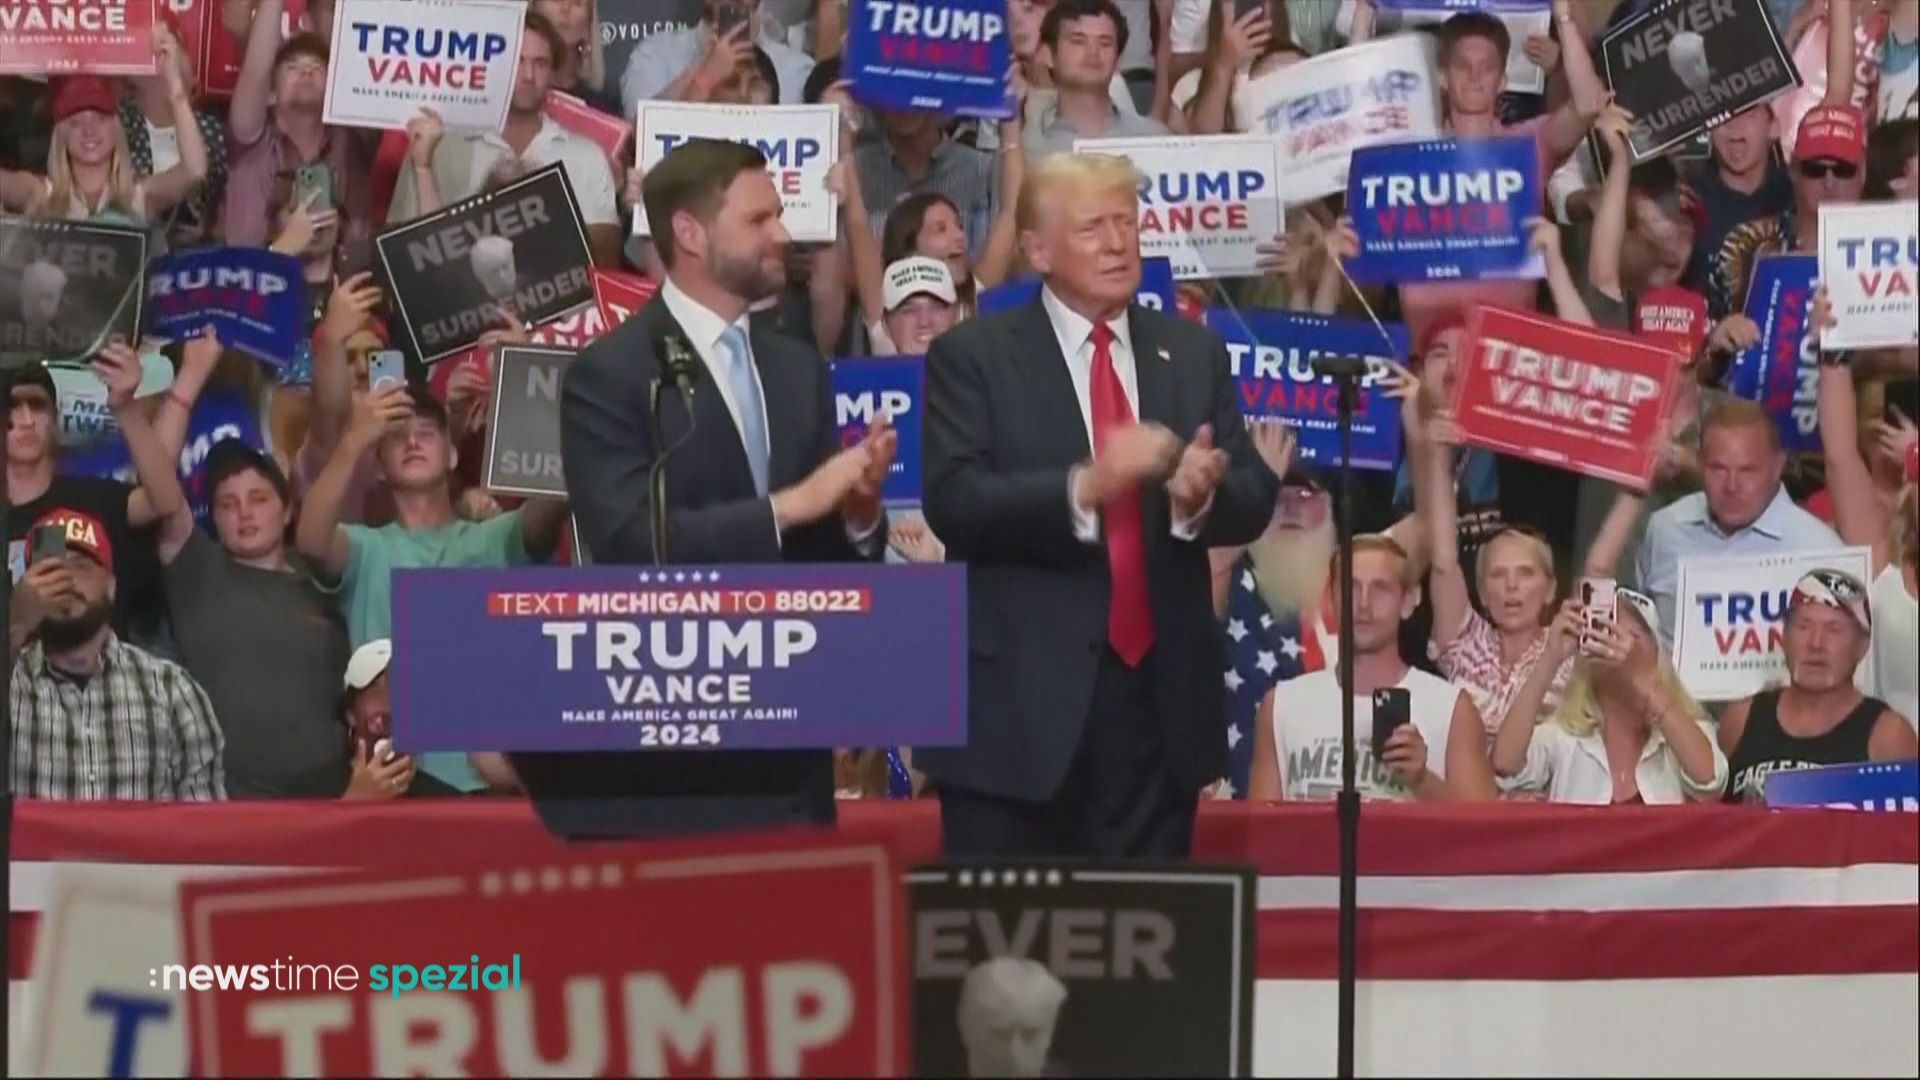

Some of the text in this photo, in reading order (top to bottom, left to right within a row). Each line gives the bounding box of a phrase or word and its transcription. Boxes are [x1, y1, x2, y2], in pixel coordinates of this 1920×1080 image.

[0, 6, 126, 30] VANCE
[867, 1, 1003, 42] TRUMP
[1620, 0, 1736, 70] NEVER
[352, 22, 507, 62] TRUMP
[368, 57, 488, 90] VANCE
[1628, 56, 1780, 143] SURRENDER
[655, 134, 820, 168] TMP
[1137, 170, 1265, 204] RUMP
[1361, 169, 1524, 209] TRUMP
[407, 196, 550, 273] NEVER
[1141, 204, 1249, 233] ANCE
[420, 267, 590, 345] SURRENDER
[1478, 337, 1661, 405] TRUMP
[1491, 374, 1637, 435] VANCE
[498, 591, 861, 615] TEXT MICHIGAN TO 88022
[542, 621, 818, 670] TRUMP
[606, 675, 751, 704] VANCE
[562, 710, 605, 722] MAKE
[611, 709, 681, 721] AMERICA
[687, 709, 738, 720] GREAT
[640, 724, 721, 746] 2024
[915, 909, 1177, 980] EVER
[245, 960, 857, 1078] TRUMP
